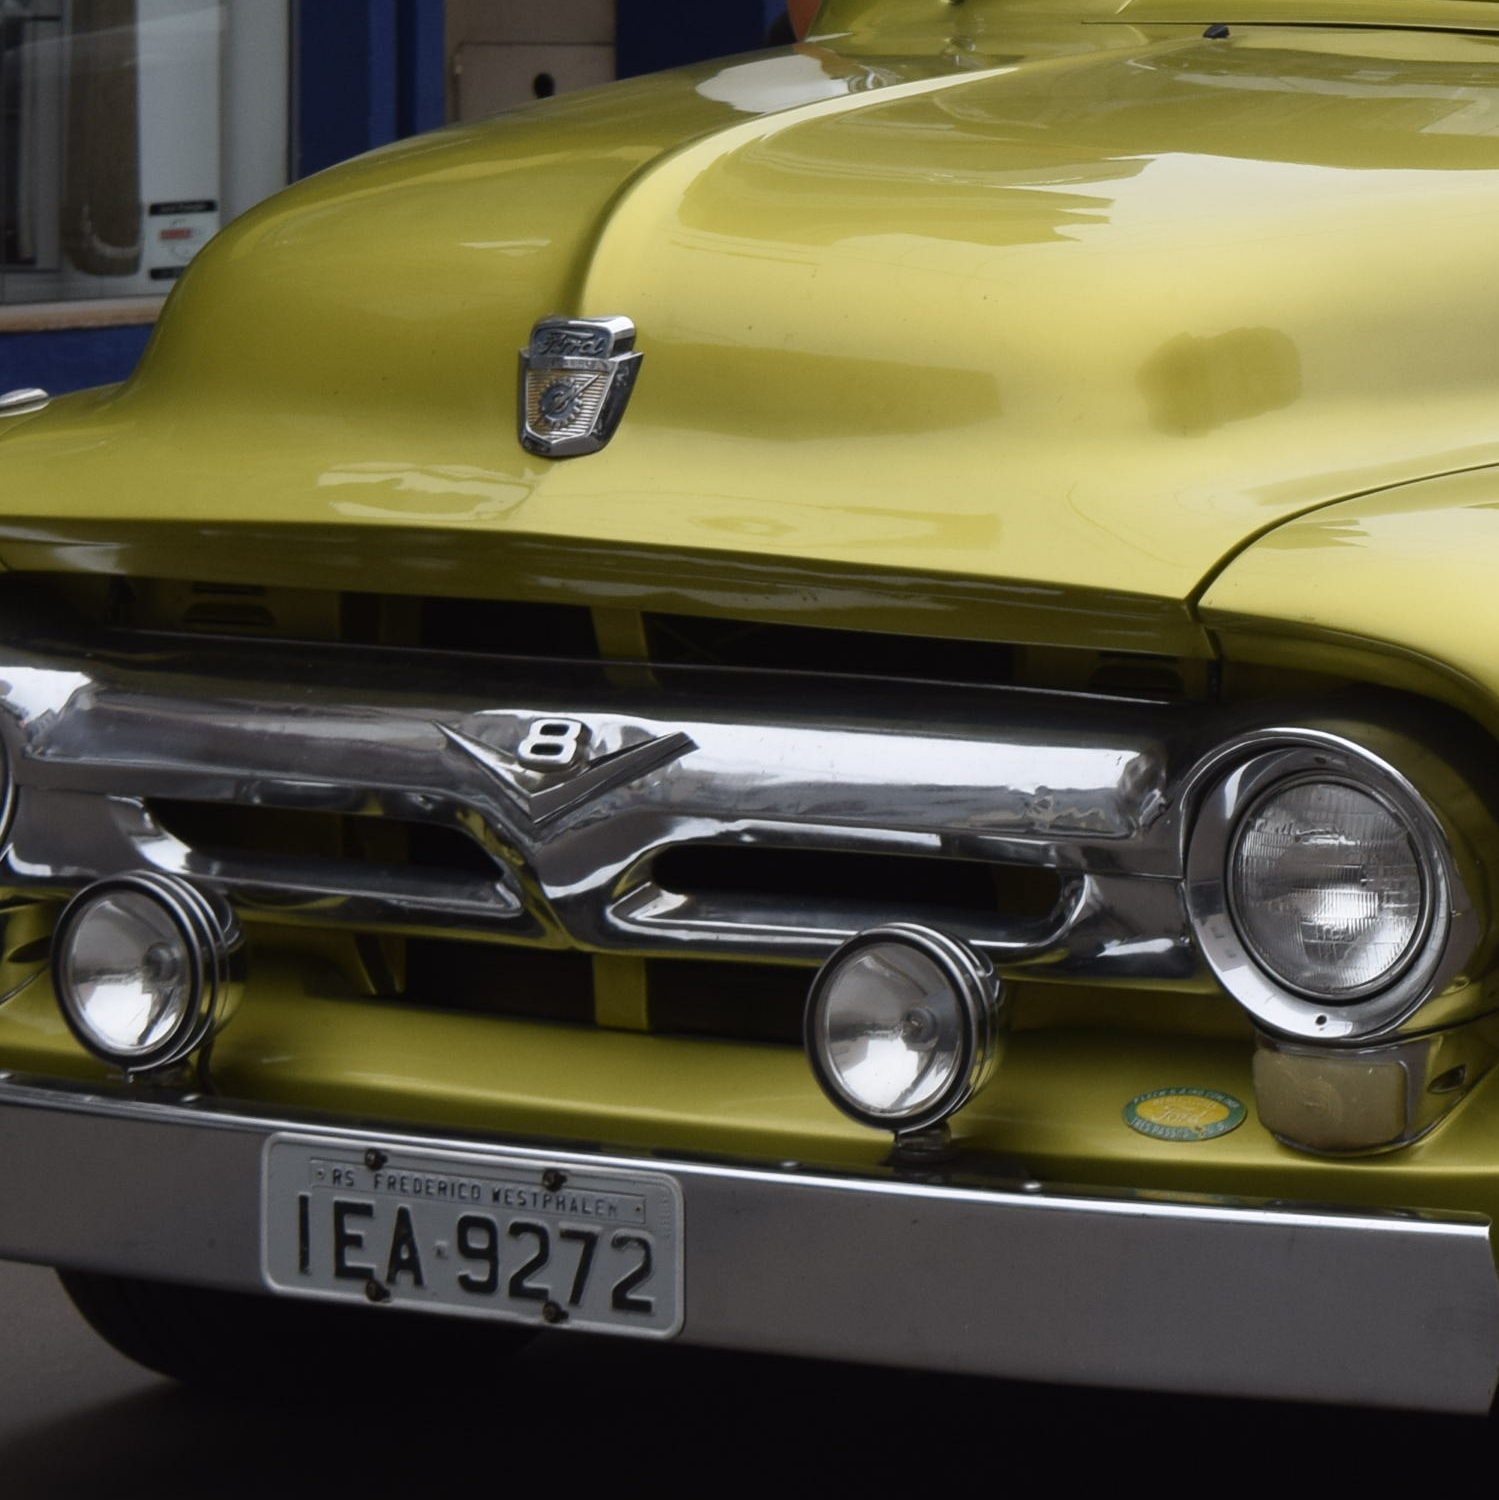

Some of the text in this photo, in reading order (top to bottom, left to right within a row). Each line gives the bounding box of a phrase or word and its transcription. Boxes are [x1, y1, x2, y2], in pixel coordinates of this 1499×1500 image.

[332, 1168, 619, 1218] RS FREDERICO WESTPHALEN
